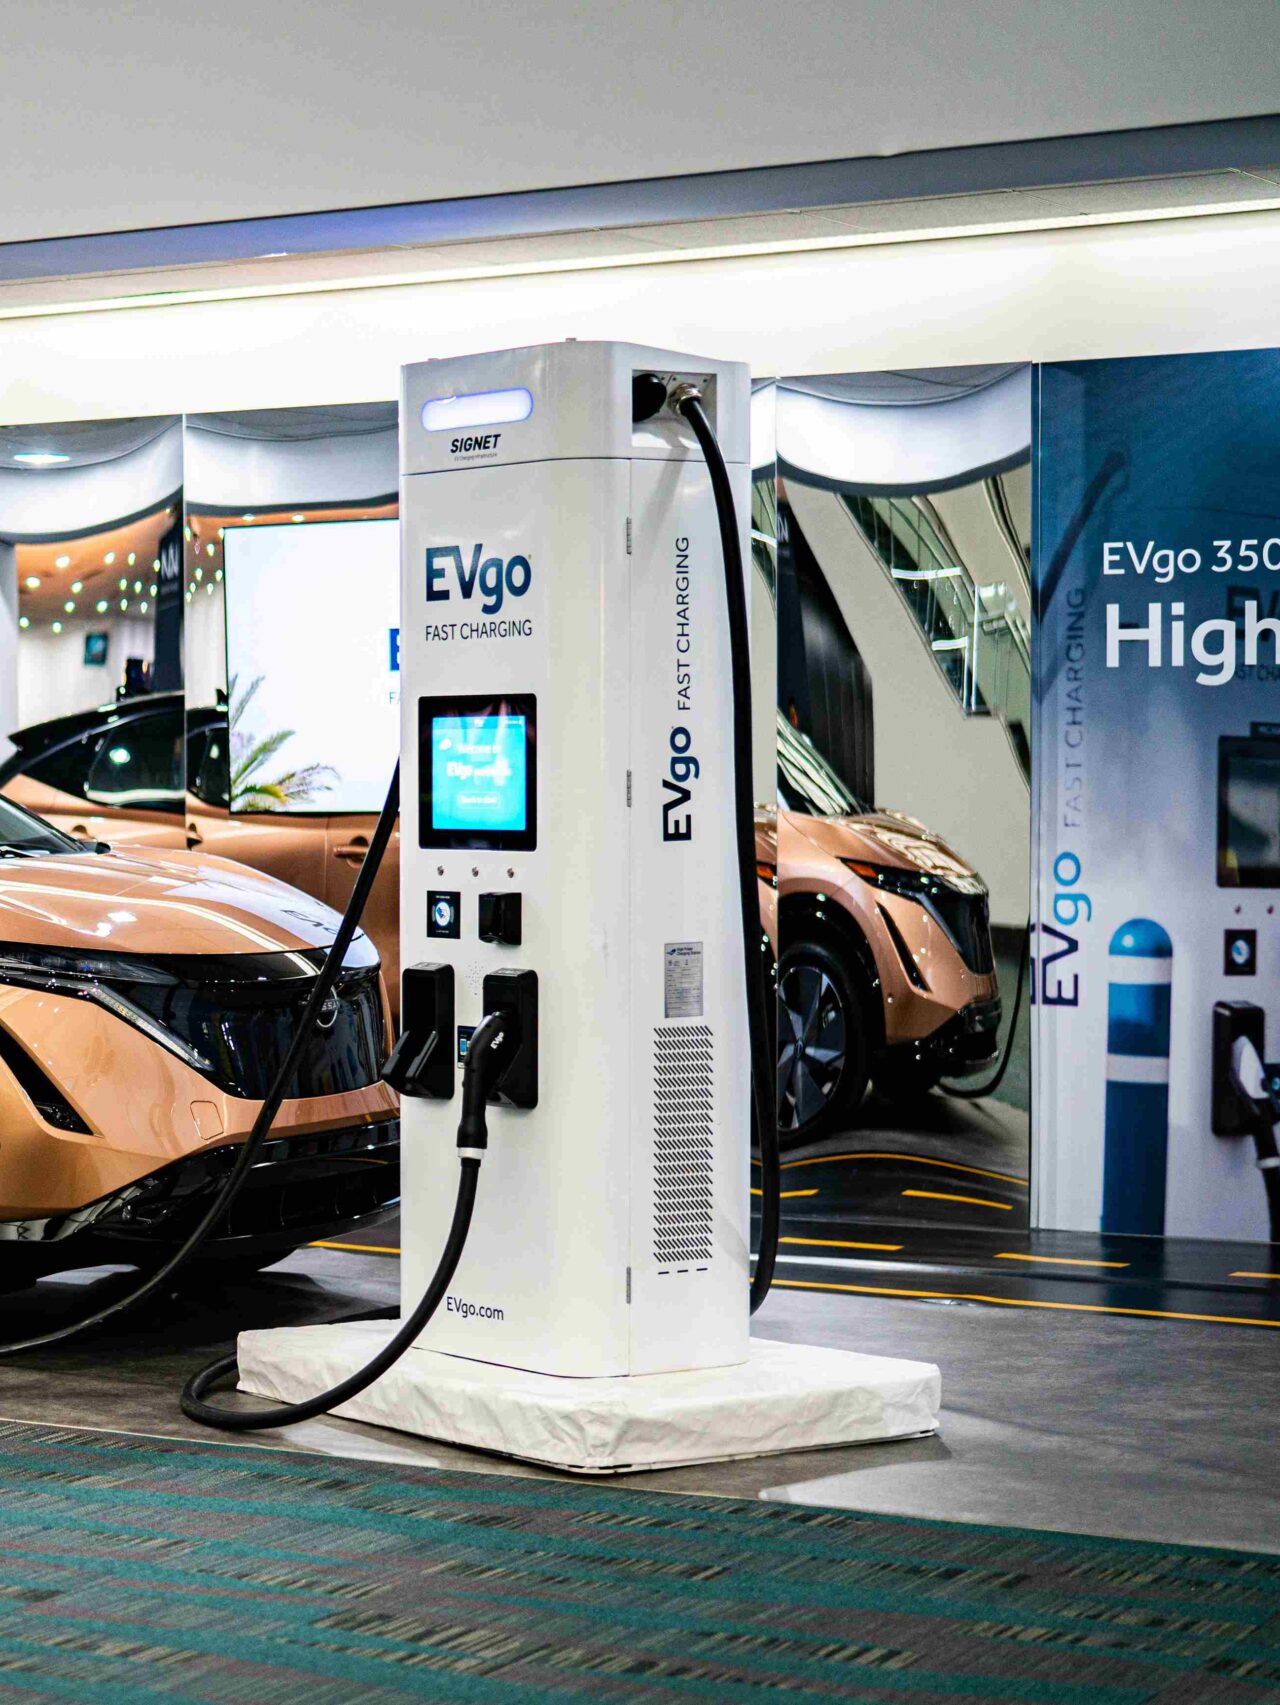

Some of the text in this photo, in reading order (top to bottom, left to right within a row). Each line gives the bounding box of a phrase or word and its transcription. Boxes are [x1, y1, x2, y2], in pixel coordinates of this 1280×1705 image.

[450, 433, 502, 453] SIGNET
[426, 543, 532, 615] EVgo
[1103, 537, 1280, 583] EVgo 350
[425, 619, 533, 641] FAST CHARGING
[1106, 600, 1280, 687] High
[662, 536, 700, 842] EVgo FAST CHARGING
[1041, 587, 1093, 1007] EVgo FAST CHARGING
[446, 1296, 504, 1321] EVgo.com
